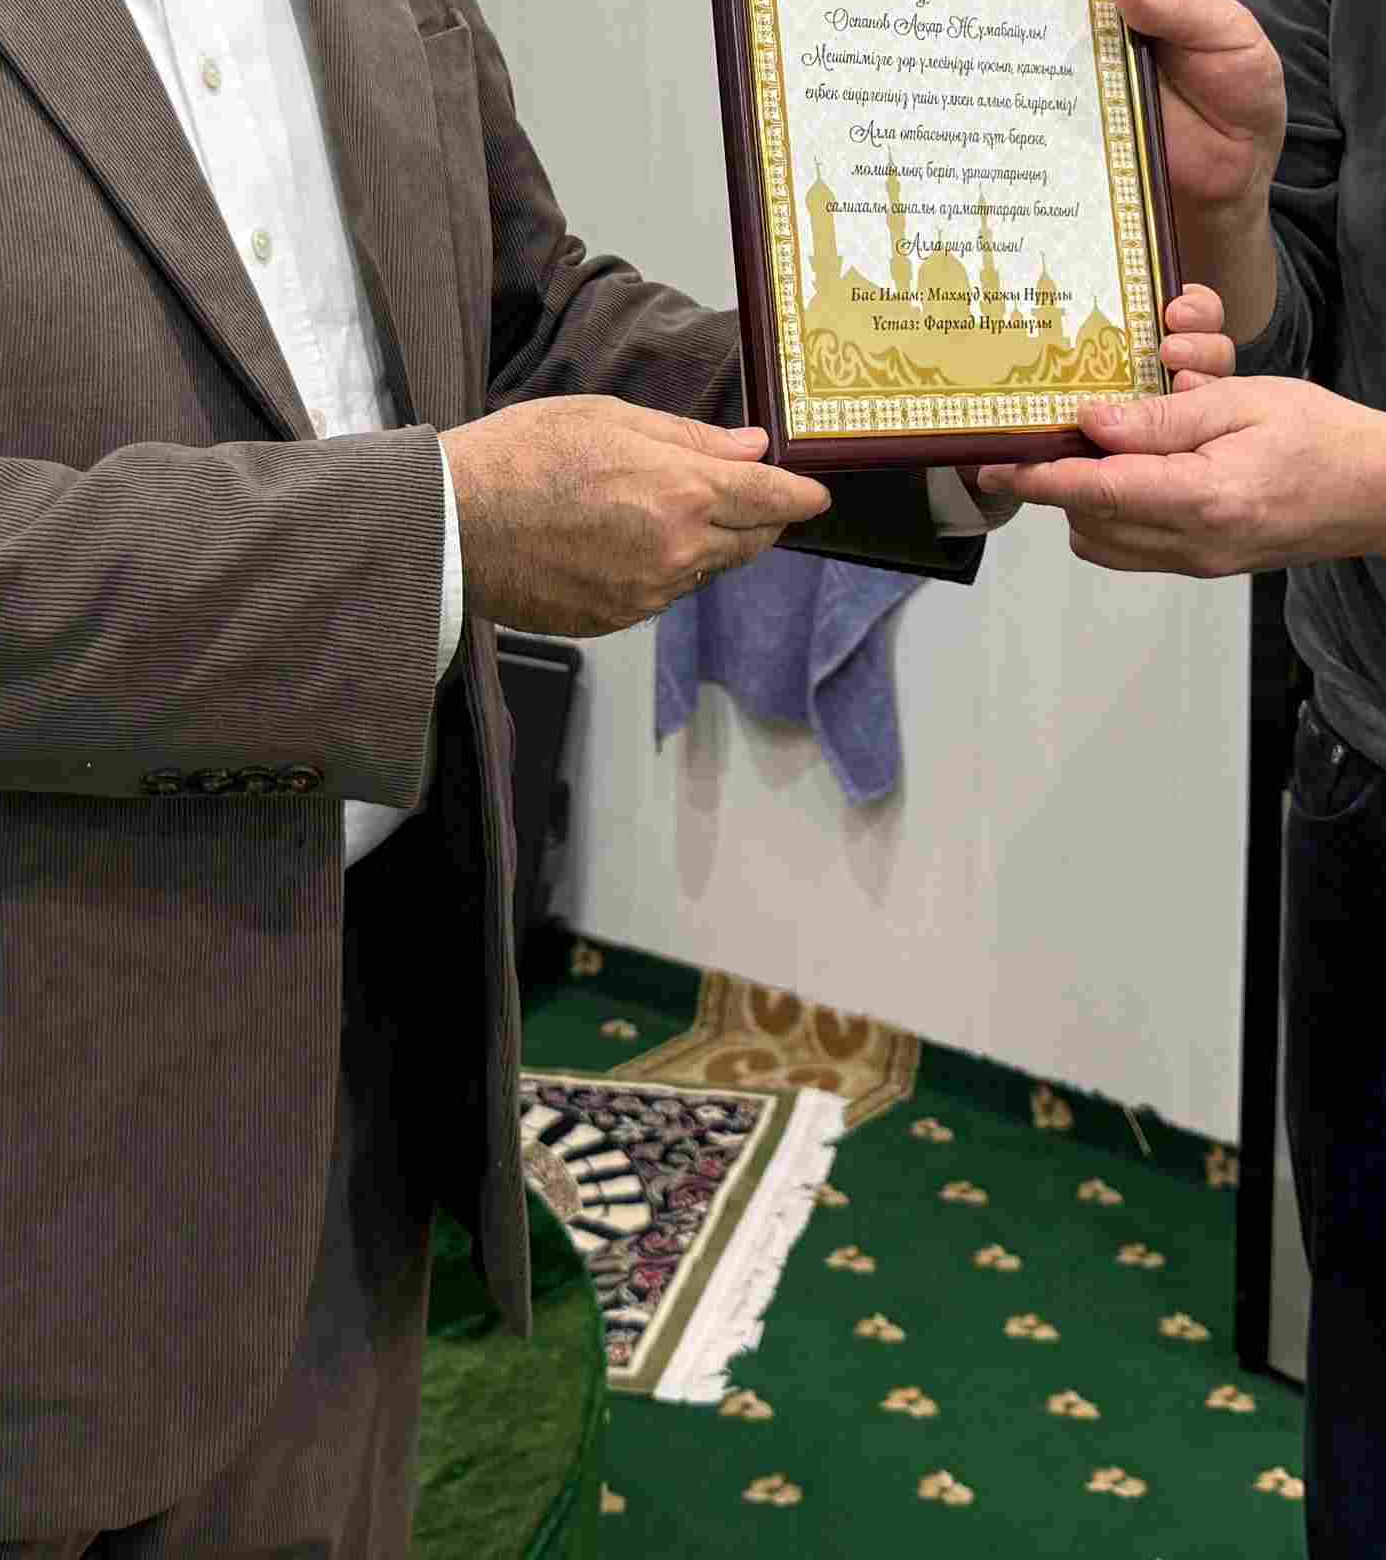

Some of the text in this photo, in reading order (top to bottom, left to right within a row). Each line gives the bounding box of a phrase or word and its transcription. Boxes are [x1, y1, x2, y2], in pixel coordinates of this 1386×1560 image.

[823, 7, 891, 32] Оспанов
[893, 13, 944, 40] Асқар
[896, 55, 917, 73] зор
[849, 119, 897, 148] Алла
[850, 286, 877, 302] Бас
[878, 286, 925, 303] Имам:
[982, 288, 1021, 305] қажы
[923, 314, 976, 336] Фархад
